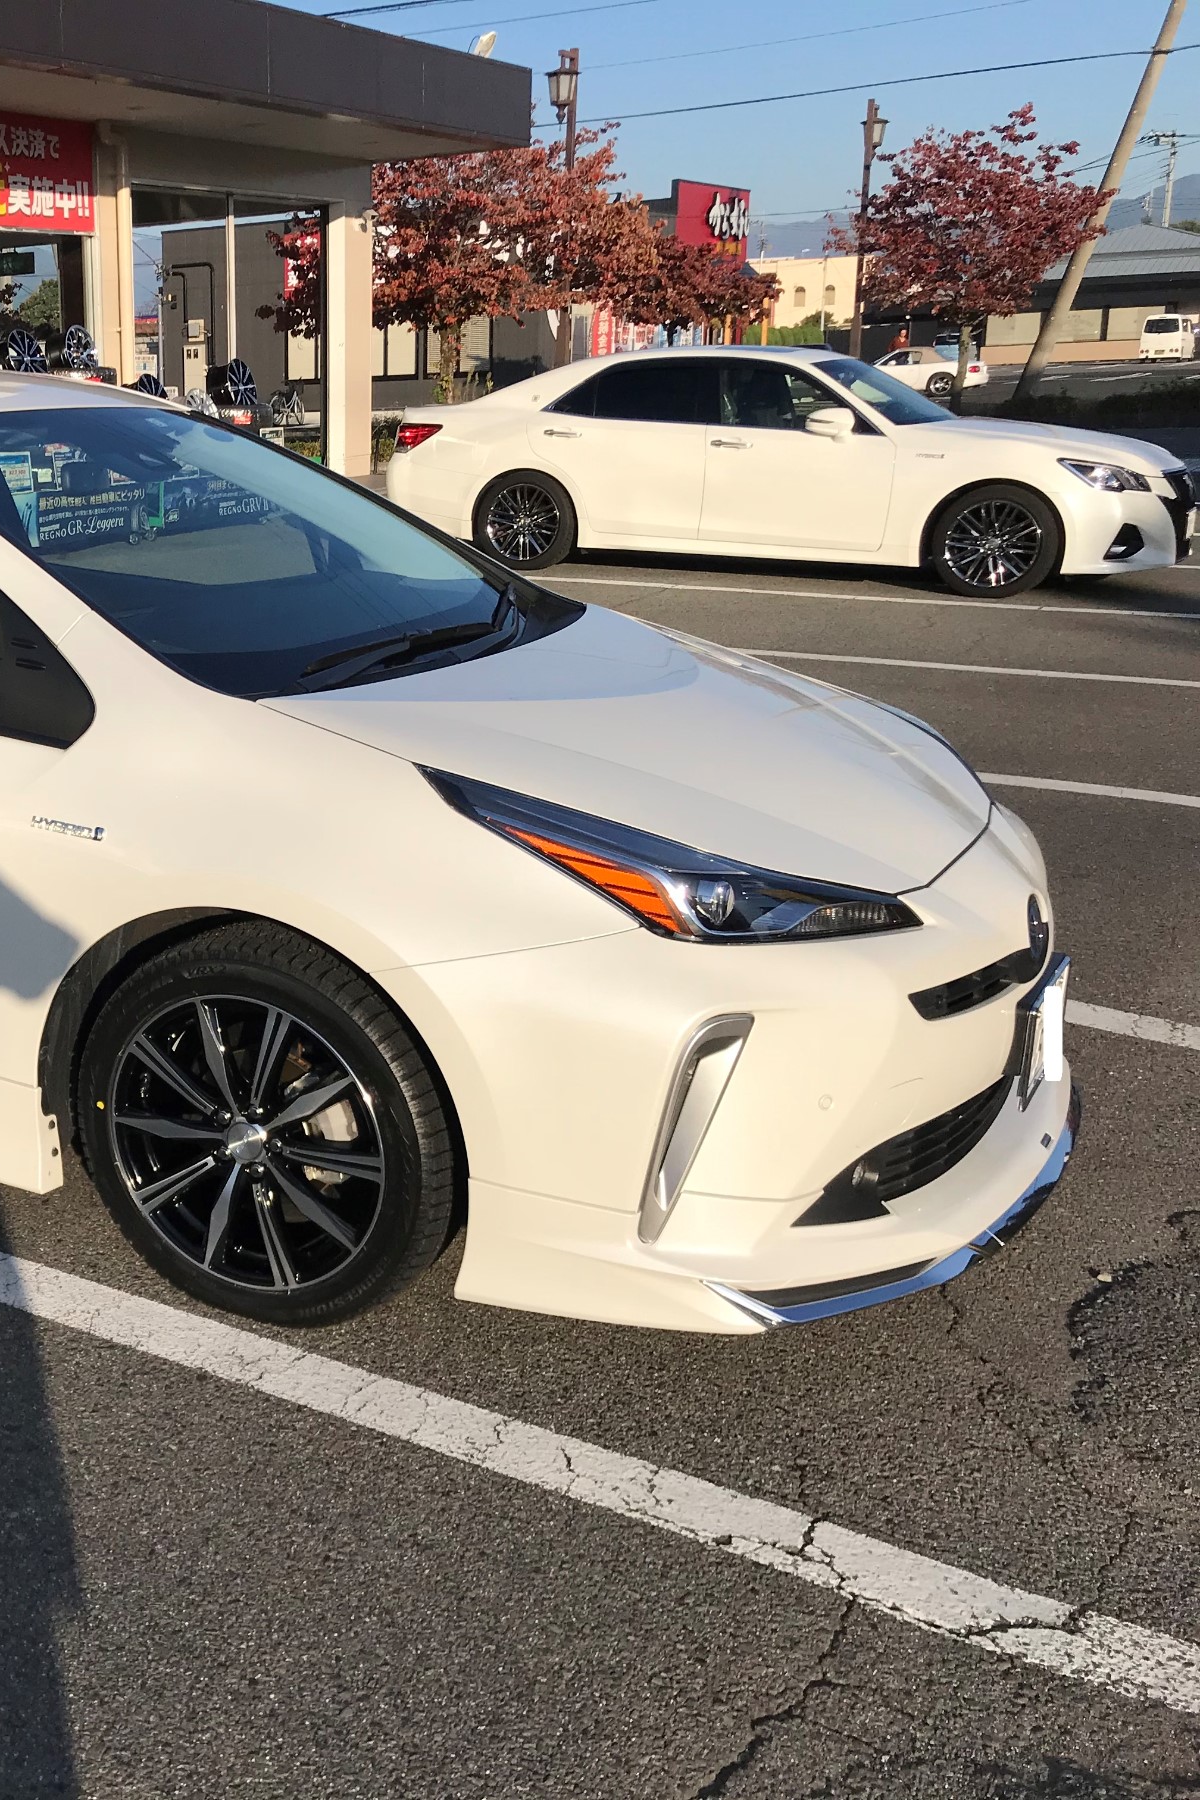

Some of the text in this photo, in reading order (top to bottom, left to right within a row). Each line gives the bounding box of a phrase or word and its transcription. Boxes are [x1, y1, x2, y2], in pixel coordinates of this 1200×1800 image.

[218, 505, 243, 517] REGNO
[39, 529, 68, 542] REGNO
[67, 515, 125, 537] GR-Leggera
